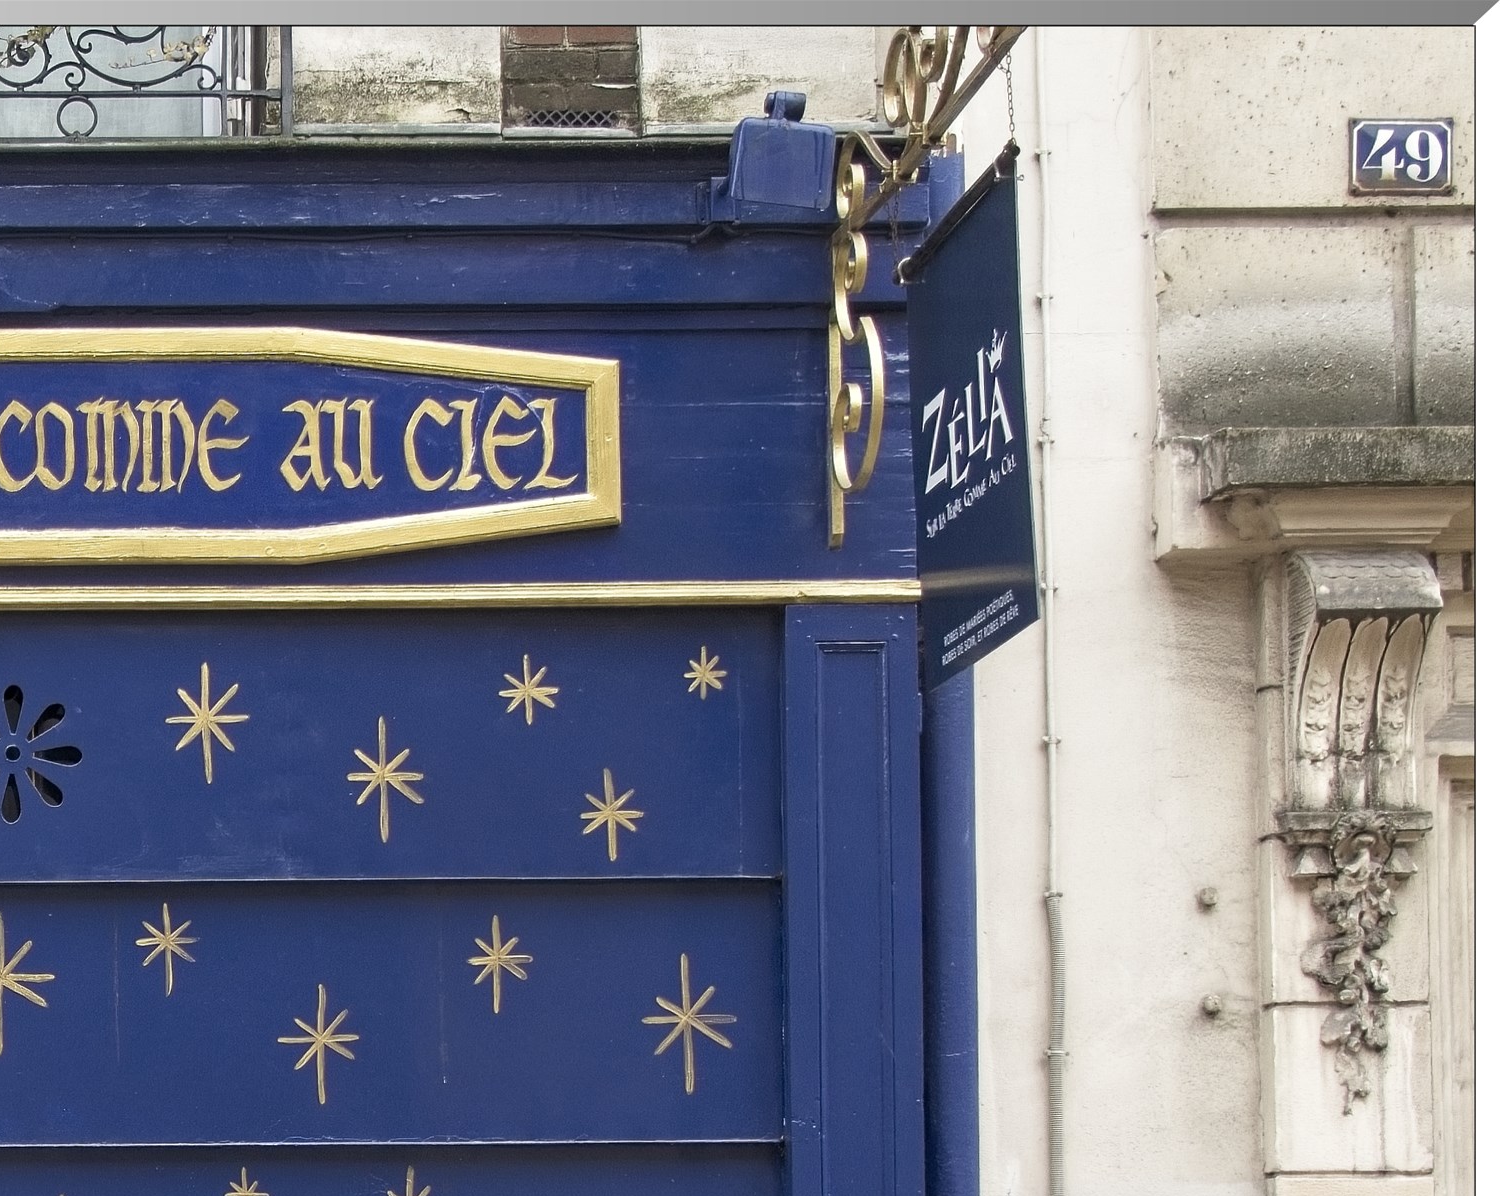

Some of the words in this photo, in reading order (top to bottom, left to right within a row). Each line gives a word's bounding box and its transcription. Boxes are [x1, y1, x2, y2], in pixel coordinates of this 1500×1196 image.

[1362, 129, 1443, 183] 49
[279, 398, 383, 492] AU
[403, 397, 578, 492] CIEL
[921, 347, 1014, 494] ZÉLIA
